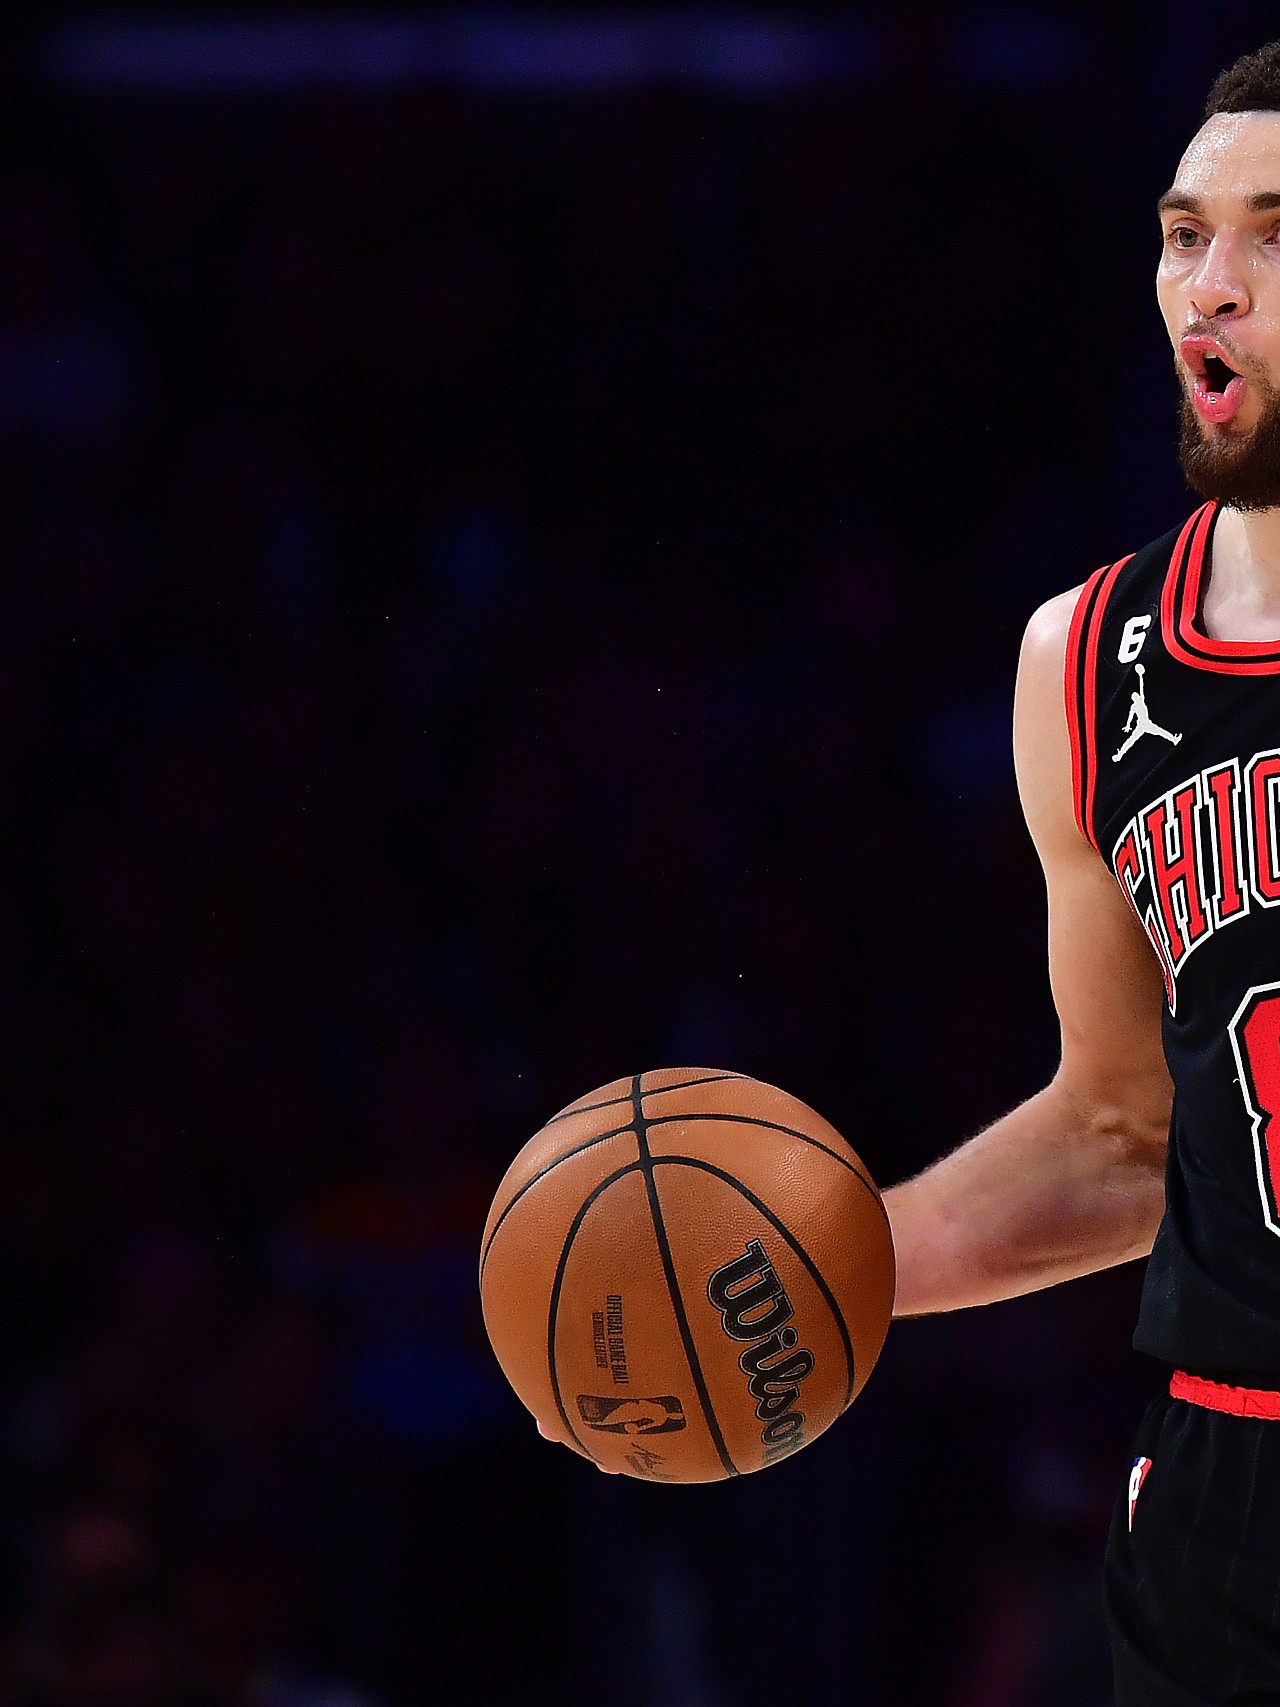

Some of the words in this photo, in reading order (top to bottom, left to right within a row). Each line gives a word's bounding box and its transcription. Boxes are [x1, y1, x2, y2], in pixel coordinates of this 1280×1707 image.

[1117, 614, 1152, 664] 6
[606, 1295, 623, 1335] OFFICIAL
[608, 1338, 626, 1363] GAME
[611, 1365, 630, 1385] BALL
